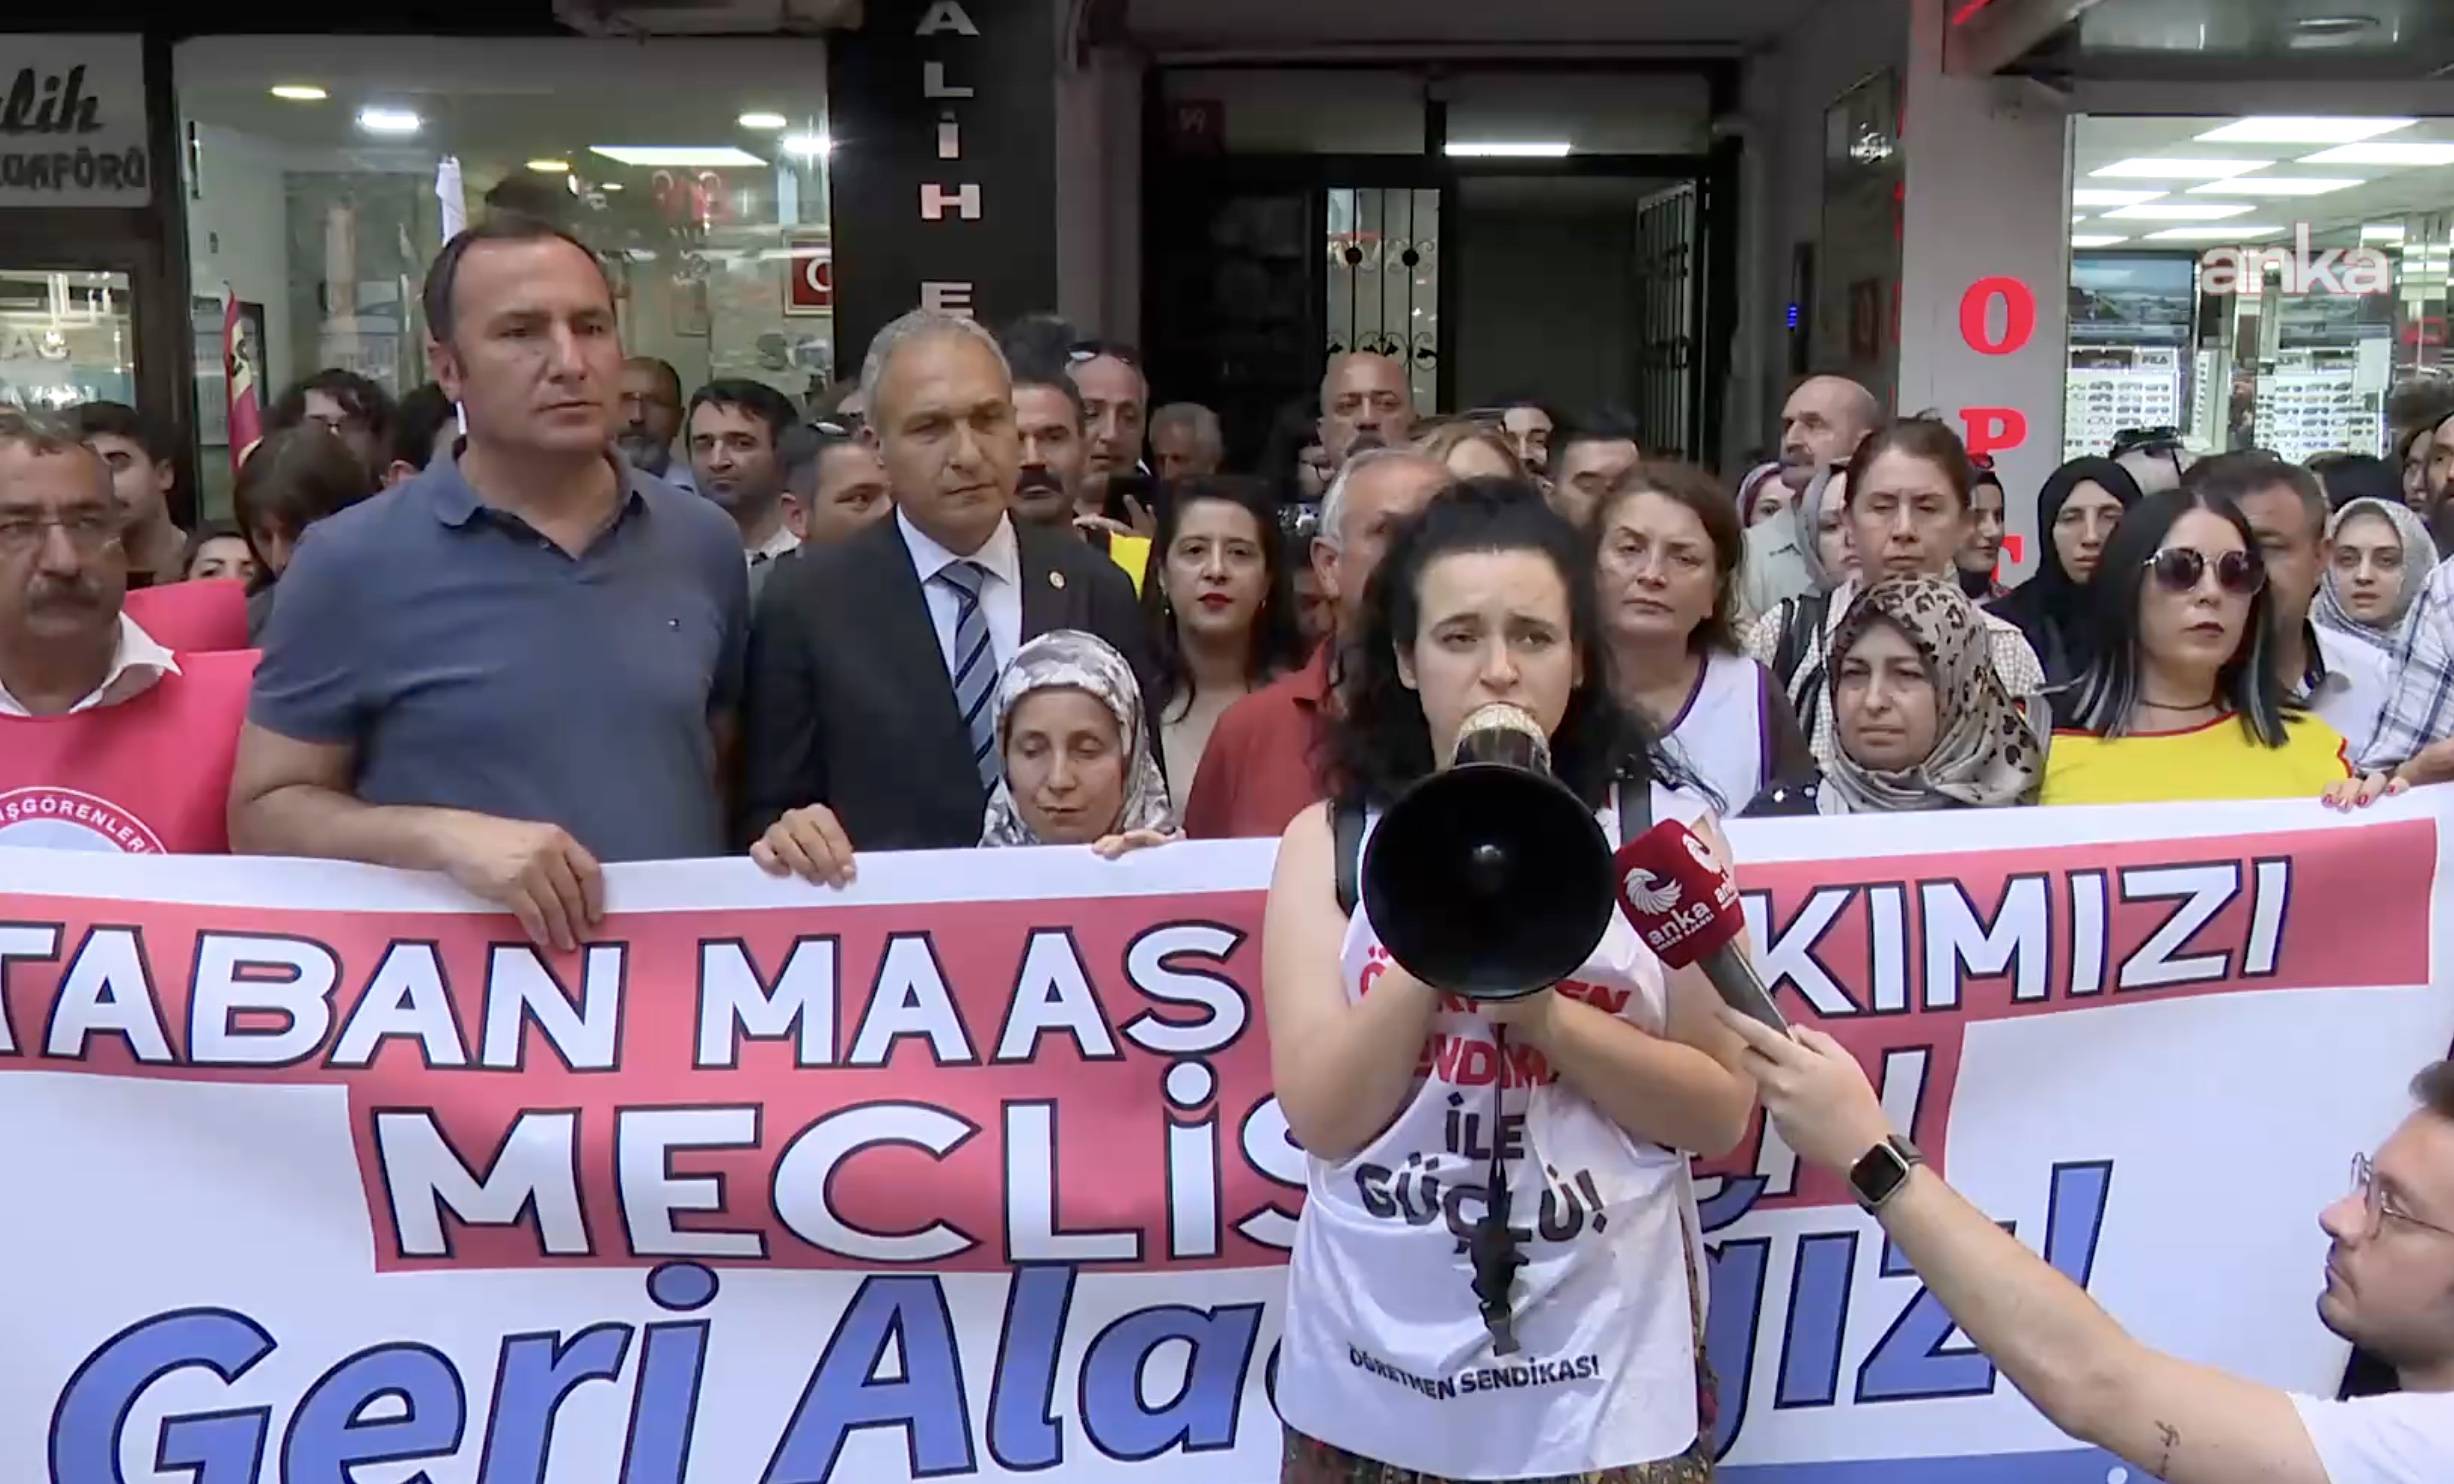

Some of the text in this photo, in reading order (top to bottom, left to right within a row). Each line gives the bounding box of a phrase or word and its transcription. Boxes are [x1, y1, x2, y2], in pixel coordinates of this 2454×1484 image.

[0, 64, 106, 135] lih
[1647, 901, 1712, 946] anka
[1740, 854, 2293, 1018] KIMIZI
[1445, 1091, 1525, 1160] İLE
[1355, 1151, 1608, 1254] GÜÇLÜ!
[47, 1260, 720, 1484] Geri
[1347, 1342, 1599, 1400] ÖĞRETMEN SENDİKASI
